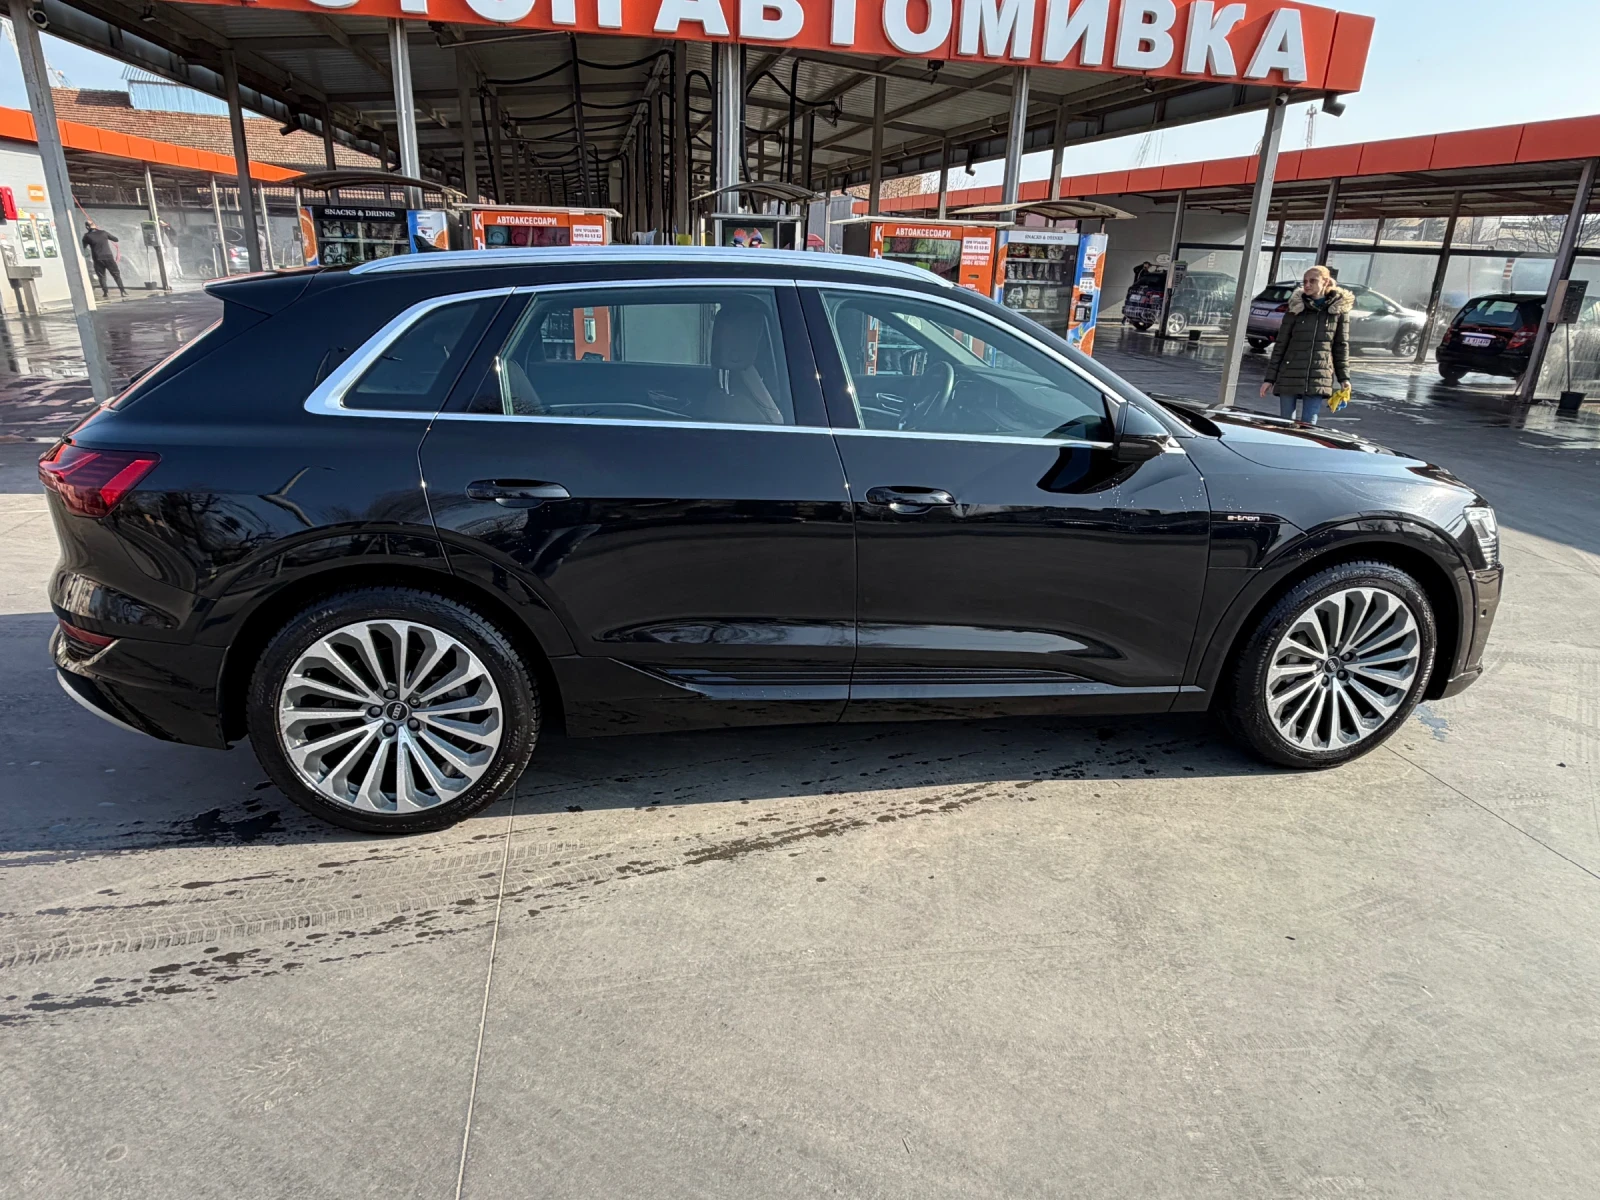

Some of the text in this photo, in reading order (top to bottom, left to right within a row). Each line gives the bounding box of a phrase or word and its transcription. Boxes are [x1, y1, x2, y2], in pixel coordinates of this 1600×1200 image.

[324, 208, 396, 218] SNACKS & DRINKS
[496, 215, 558, 226] АВТОАКСЕСОАРИ
[895, 227, 952, 238] АВТОАКСЕСОАРИ
